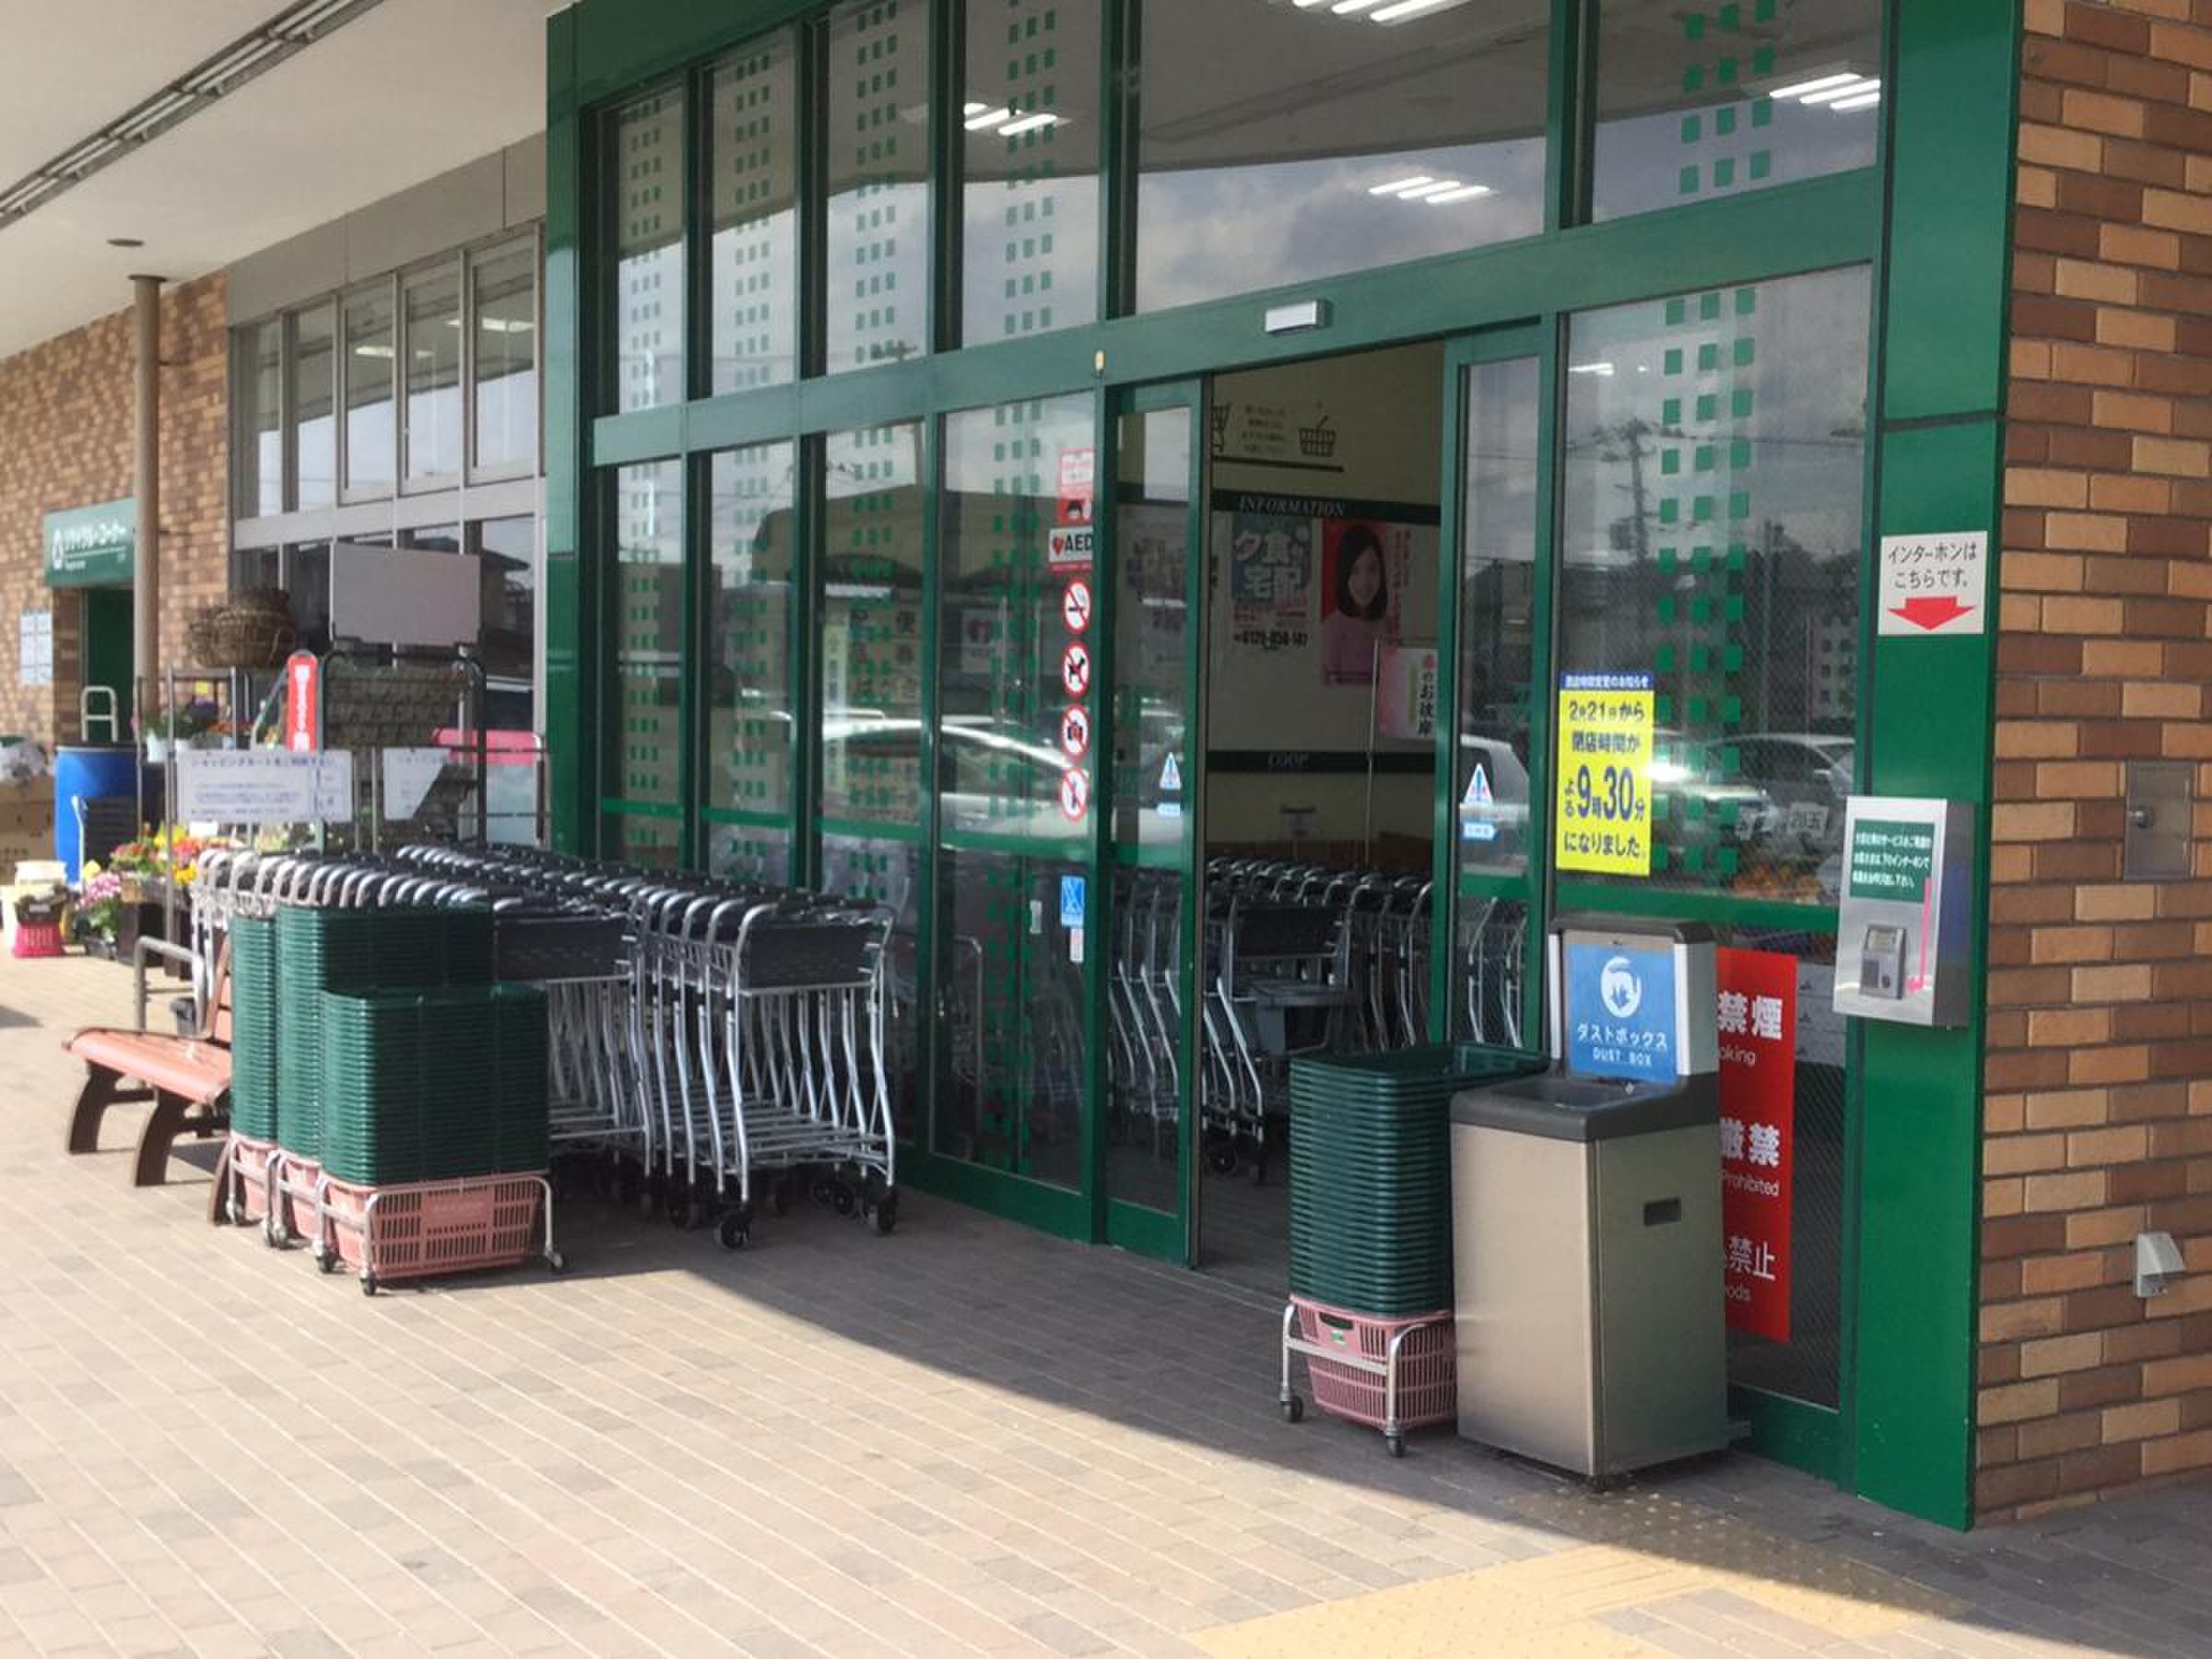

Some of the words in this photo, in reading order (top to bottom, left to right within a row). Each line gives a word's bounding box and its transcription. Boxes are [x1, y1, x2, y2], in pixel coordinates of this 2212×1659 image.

[1239, 495, 1345, 517] INFORMATION
[1888, 542, 1977, 564] インターホンは
[1571, 730, 1641, 753] 閉店時間が
[1718, 991, 1783, 1041] 禁煙
[1577, 1023, 1668, 1052] ダストボックス
[1593, 1047, 1622, 1063] DUST
[1629, 1051, 1653, 1066] BOX
[1725, 1236, 1776, 1281] 禁止
